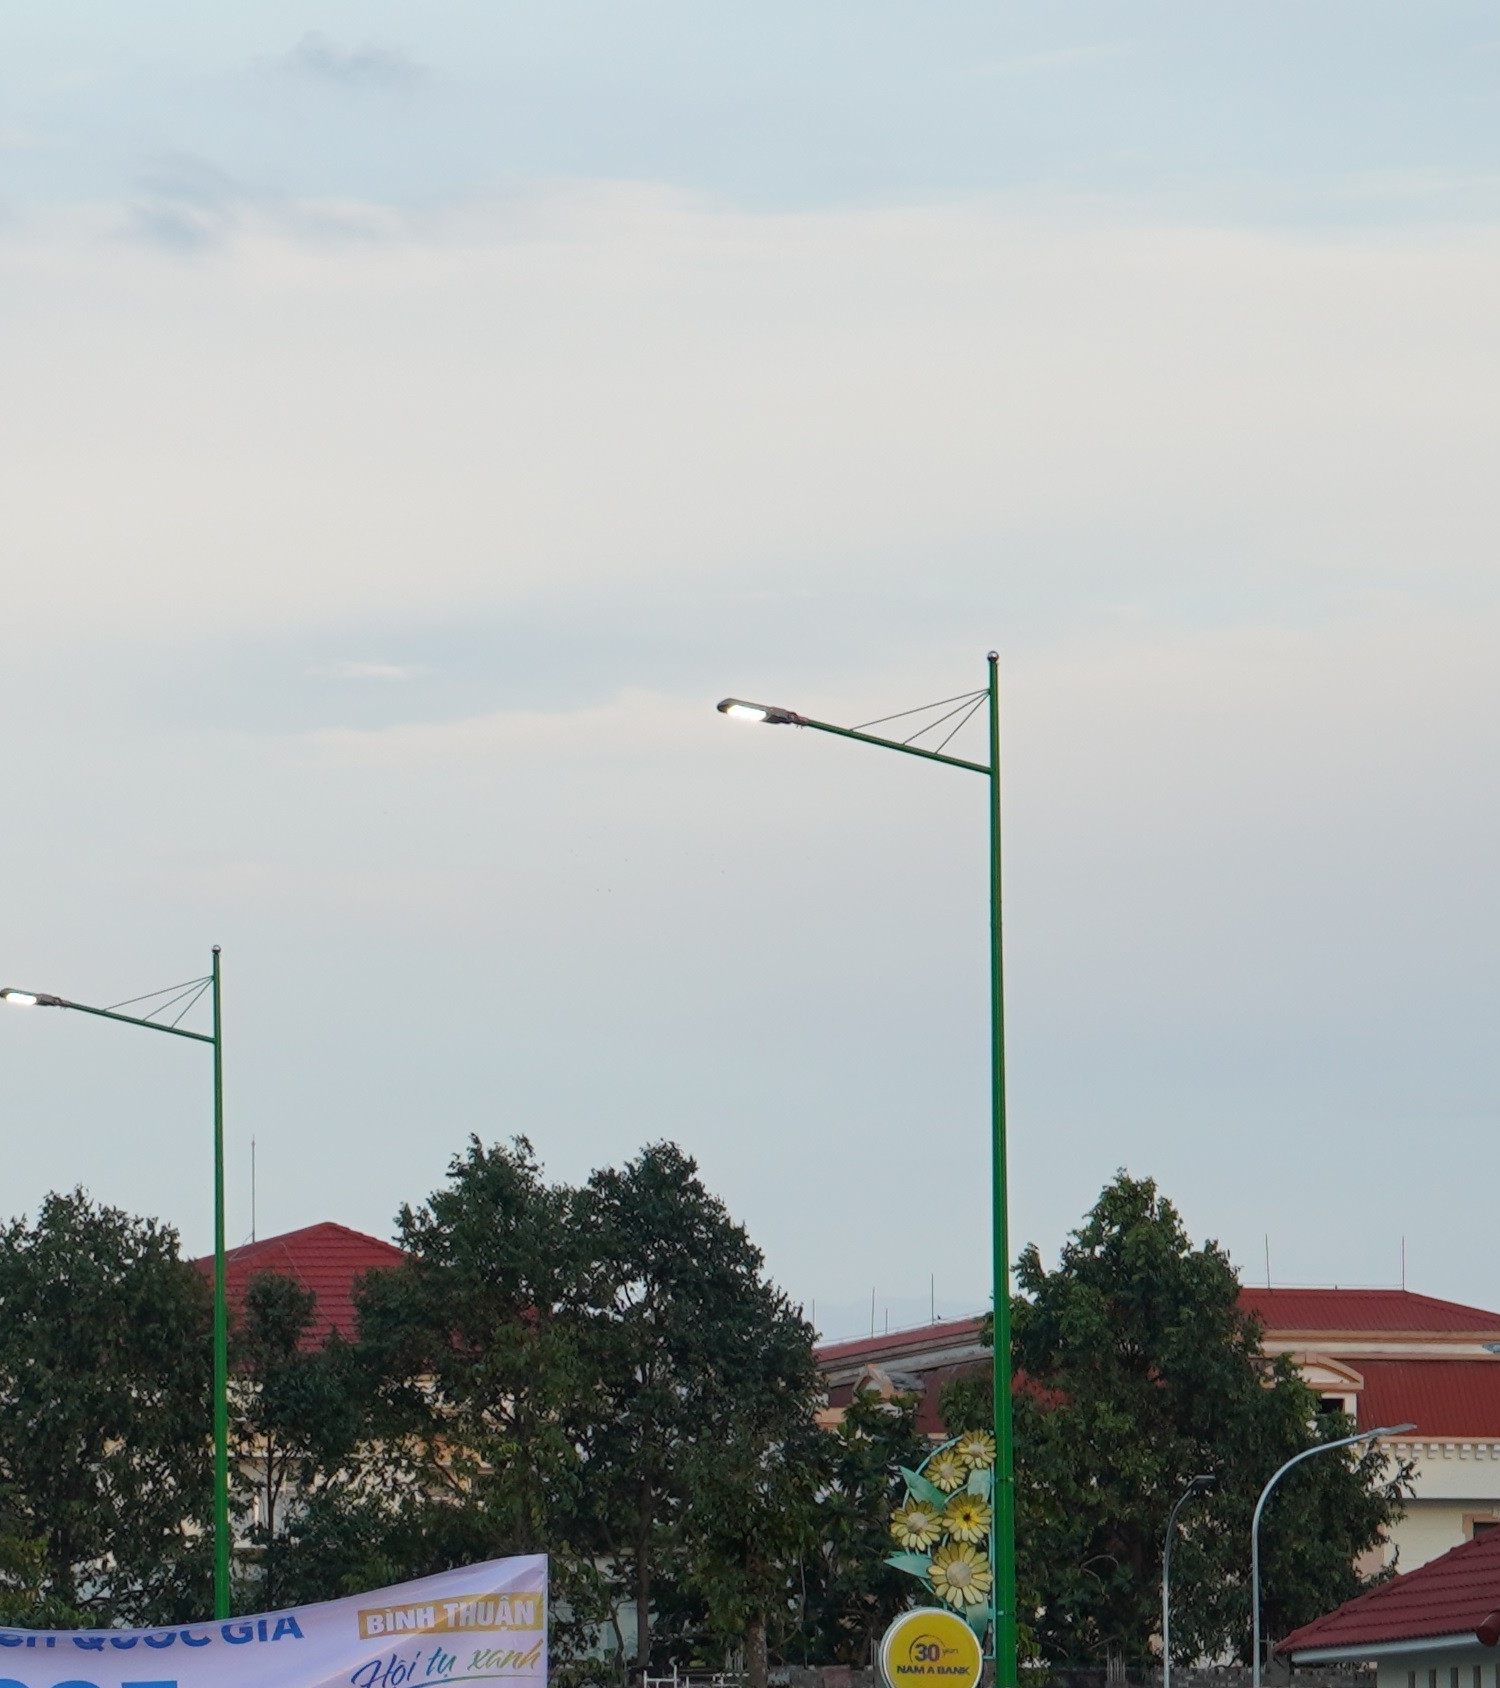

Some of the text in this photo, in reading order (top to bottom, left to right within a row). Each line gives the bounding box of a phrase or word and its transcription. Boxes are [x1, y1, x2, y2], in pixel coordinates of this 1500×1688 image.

[366, 1595, 536, 1635] BÌNH THUẬN
[425, 1646, 458, 1679] tụ
[466, 1638, 544, 1671] xanh
[914, 1643, 940, 1662] 30
[896, 1665, 970, 1676] NAM A BANK
